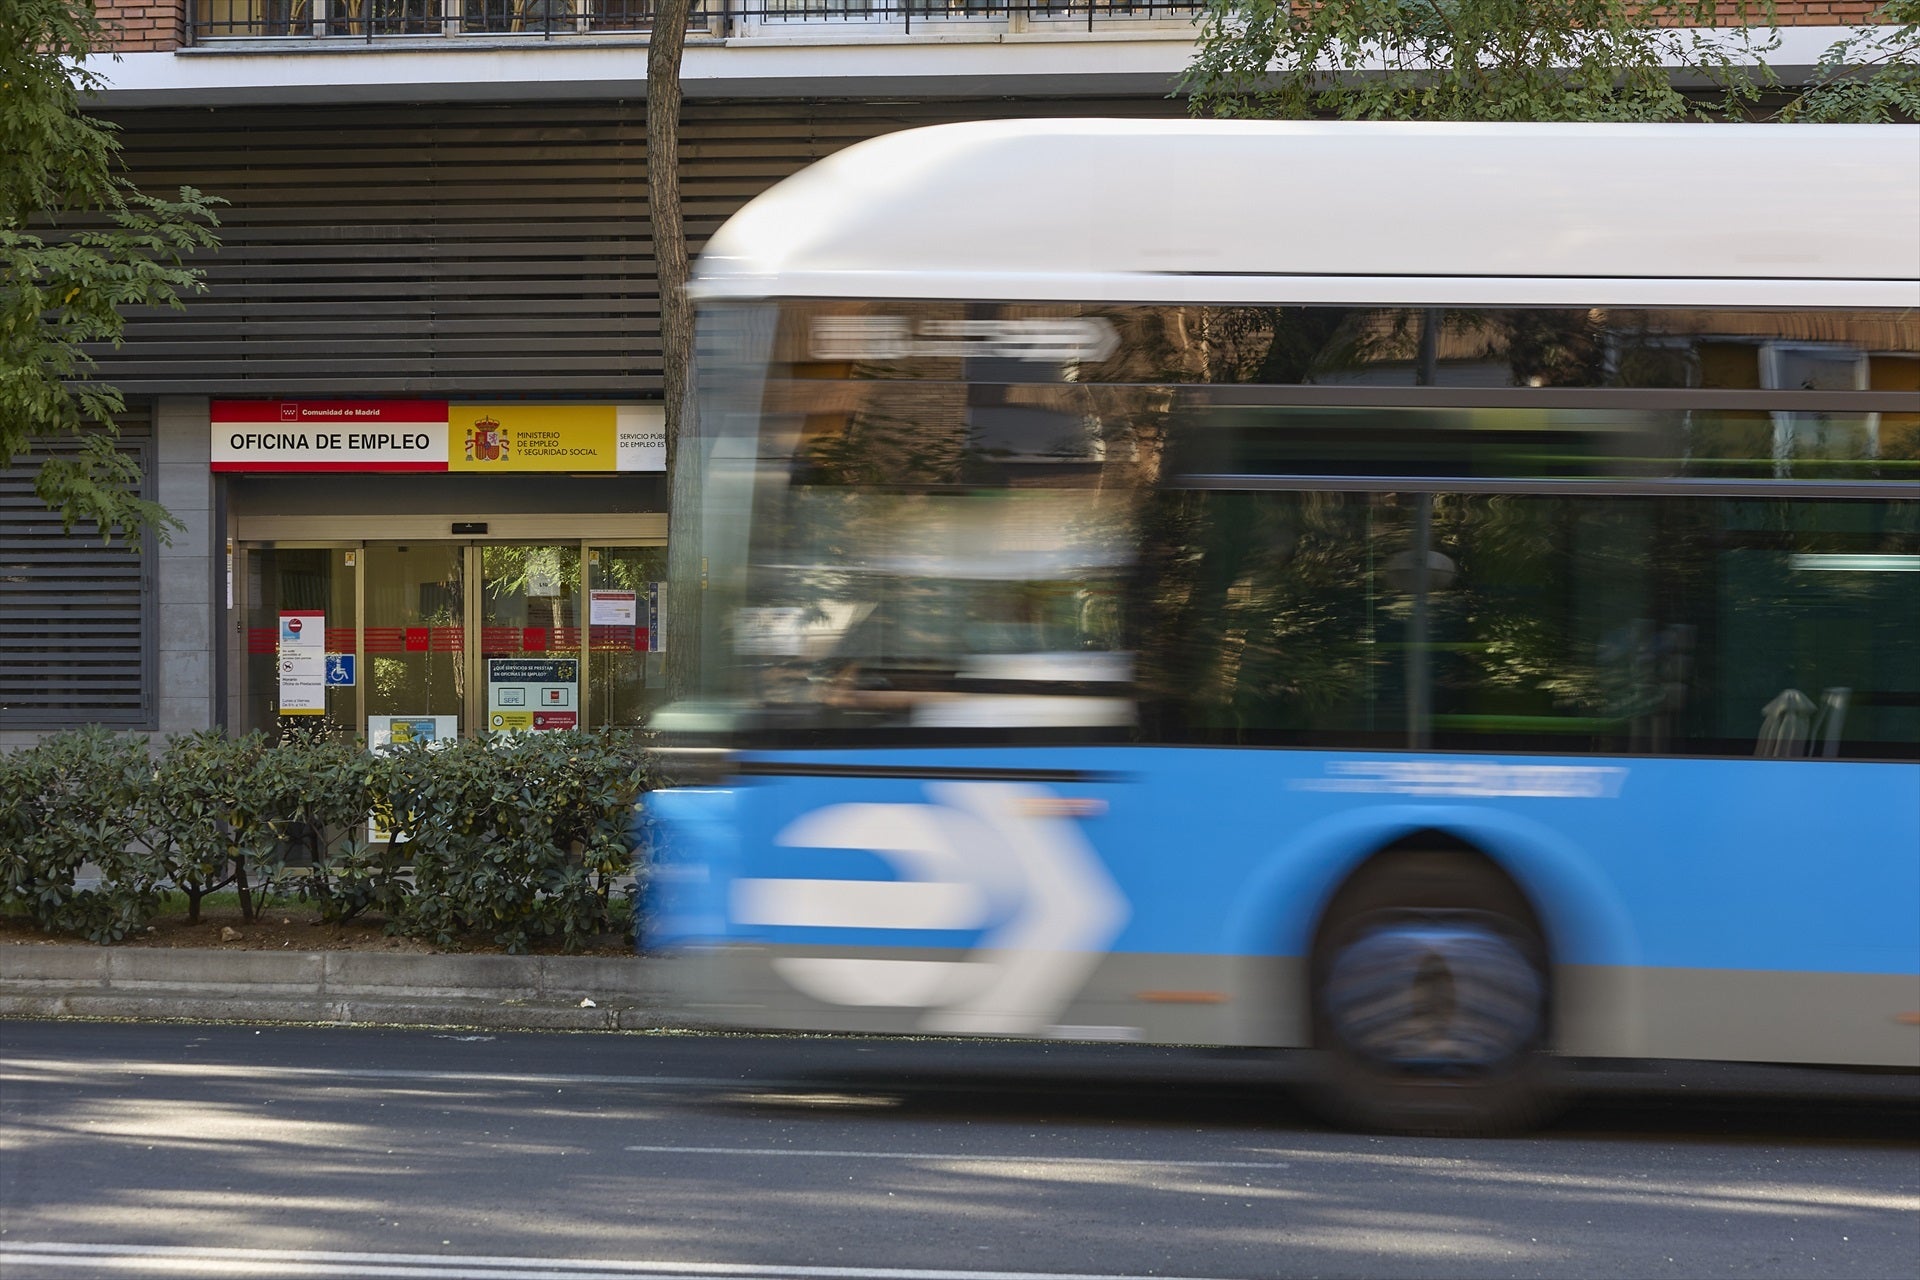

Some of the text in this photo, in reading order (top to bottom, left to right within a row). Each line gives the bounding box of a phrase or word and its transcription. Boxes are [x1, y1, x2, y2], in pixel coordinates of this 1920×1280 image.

[517, 431, 560, 439] MINISTERIO
[650, 432, 666, 440] PÚBL
[230, 433, 430, 450] OFICINA DE EMPLEO
